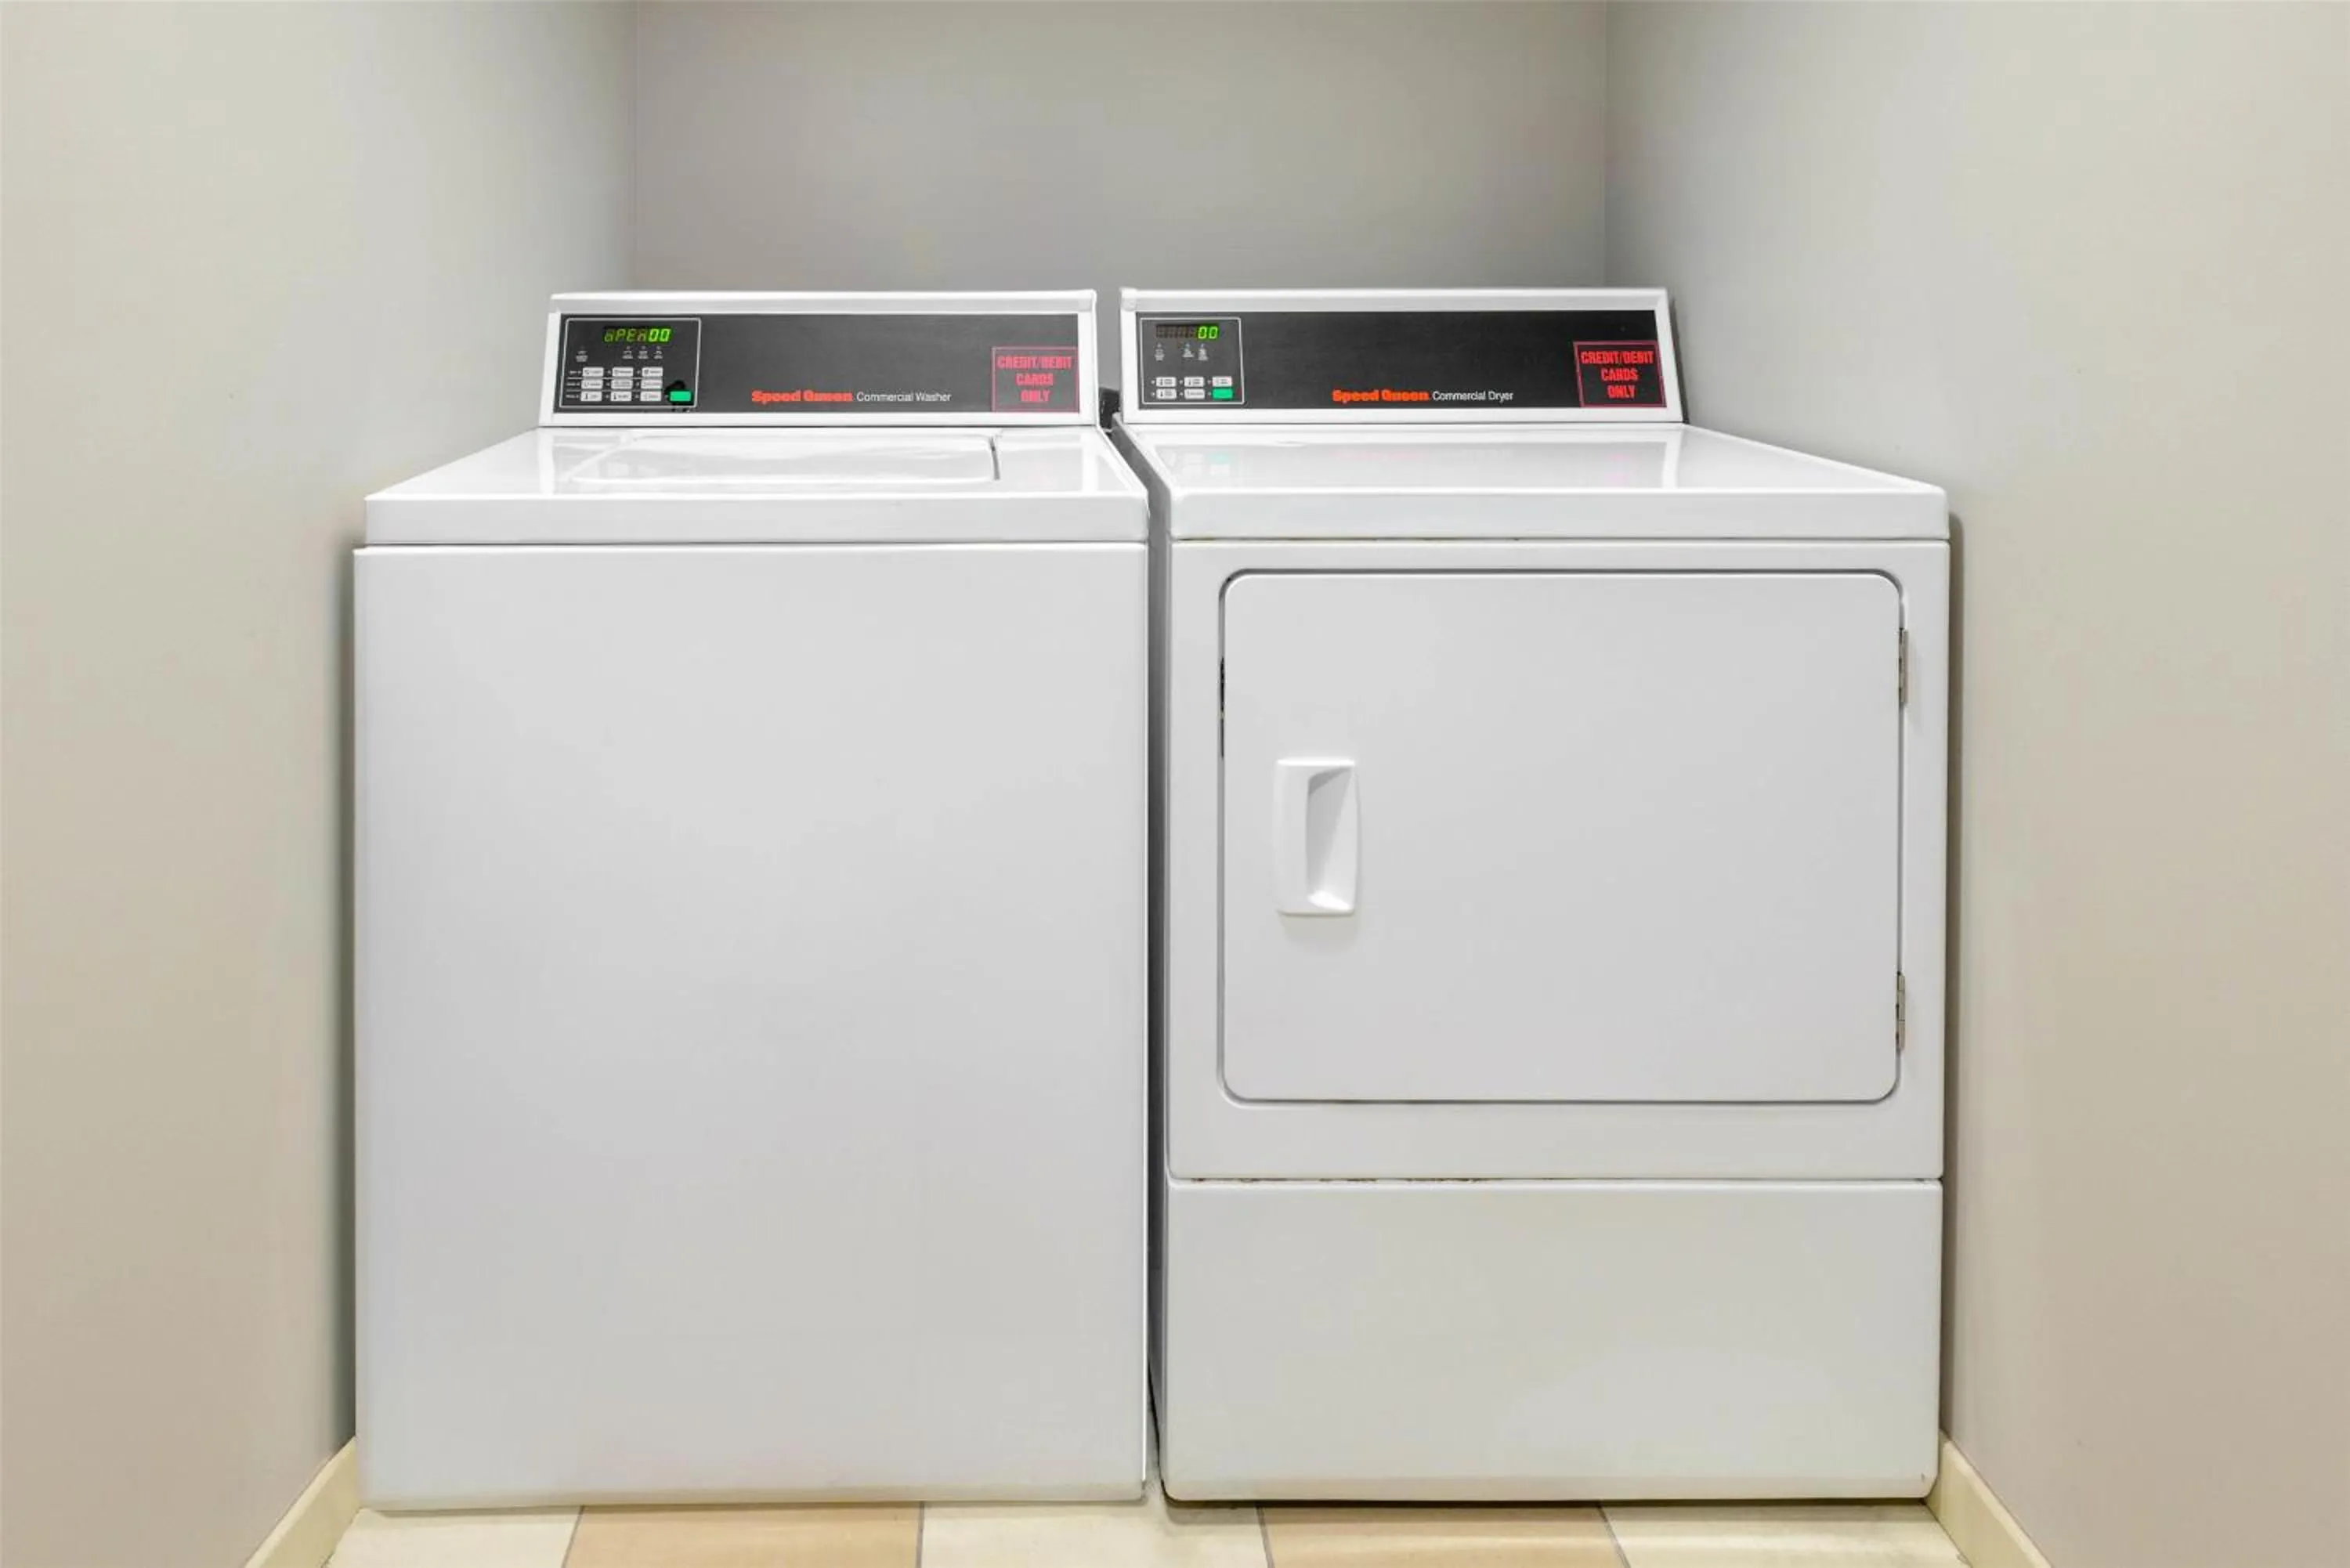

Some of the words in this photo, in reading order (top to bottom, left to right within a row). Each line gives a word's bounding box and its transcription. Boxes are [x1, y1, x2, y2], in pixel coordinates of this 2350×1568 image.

[996, 356, 1072, 369] CREDIT/DEBIT
[1581, 350, 1654, 364] CREDIT/DEBIT
[1015, 373, 1054, 386] CARDS
[1601, 367, 1639, 381] CARDS
[751, 390, 801, 404] Speed
[803, 390, 853, 402] Queen
[856, 392, 913, 402] Commercial
[916, 392, 952, 402] Washer
[1021, 389, 1051, 402] ONLY
[1332, 389, 1379, 403] Speed
[1381, 389, 1430, 401] Queen
[1432, 391, 1486, 401] Commercial
[1488, 391, 1514, 403] Dryer
[1607, 385, 1636, 399] ONLY
